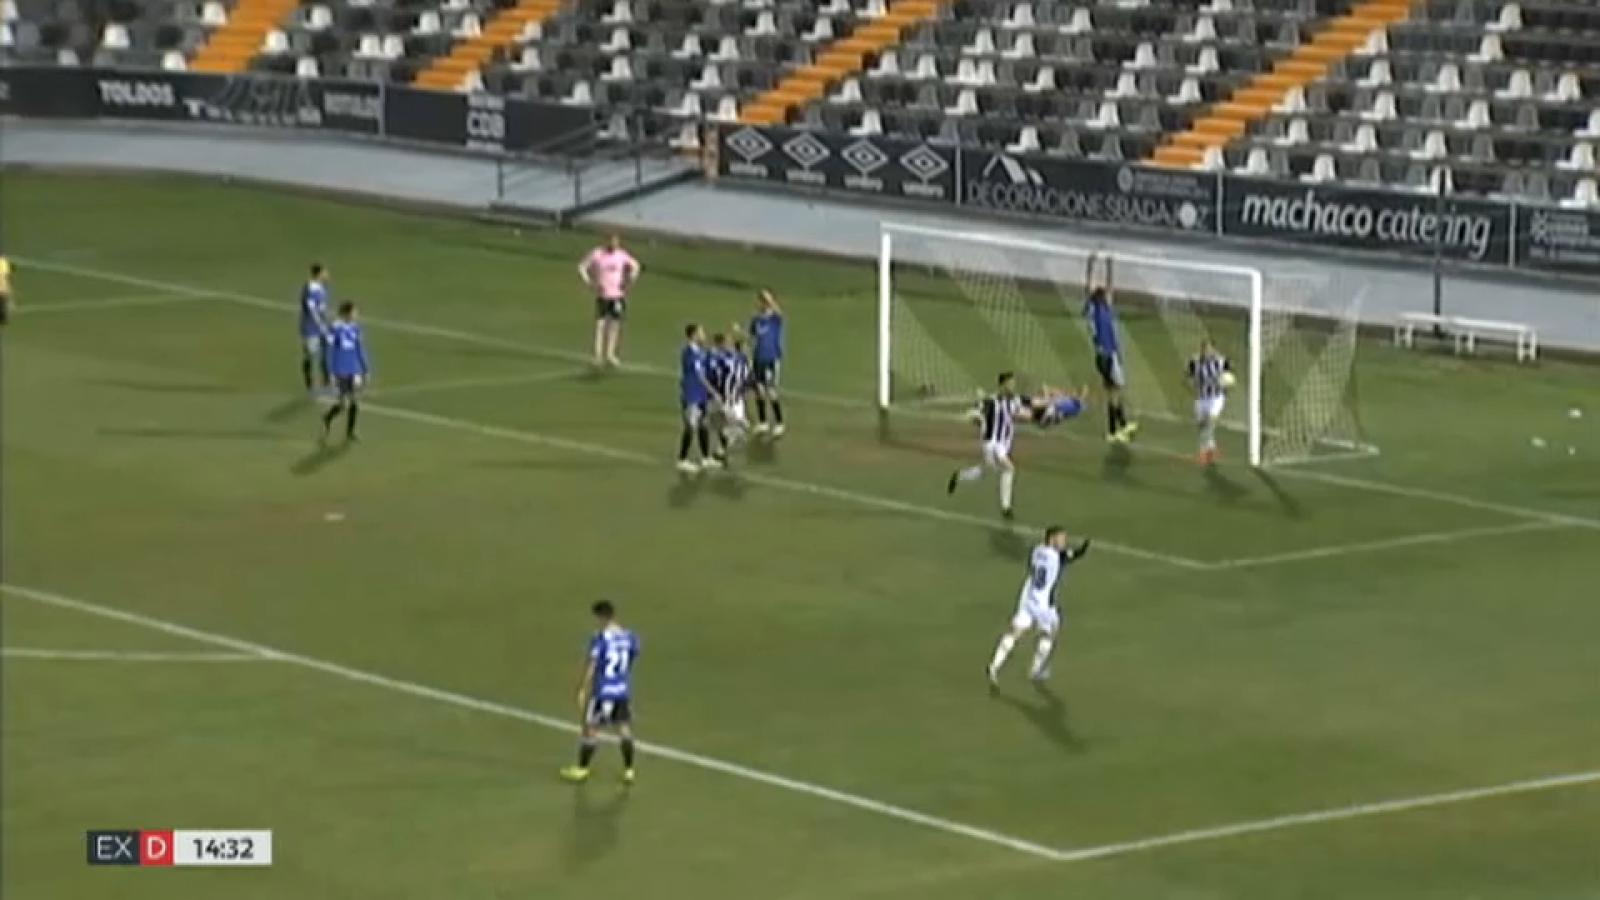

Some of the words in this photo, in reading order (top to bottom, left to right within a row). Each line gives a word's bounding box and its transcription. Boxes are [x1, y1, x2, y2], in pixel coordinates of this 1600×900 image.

[99, 79, 175, 107] TOLDOS
[466, 111, 505, 139] CDB
[1242, 190, 1373, 236] machaco
[605, 650, 629, 678] 21
